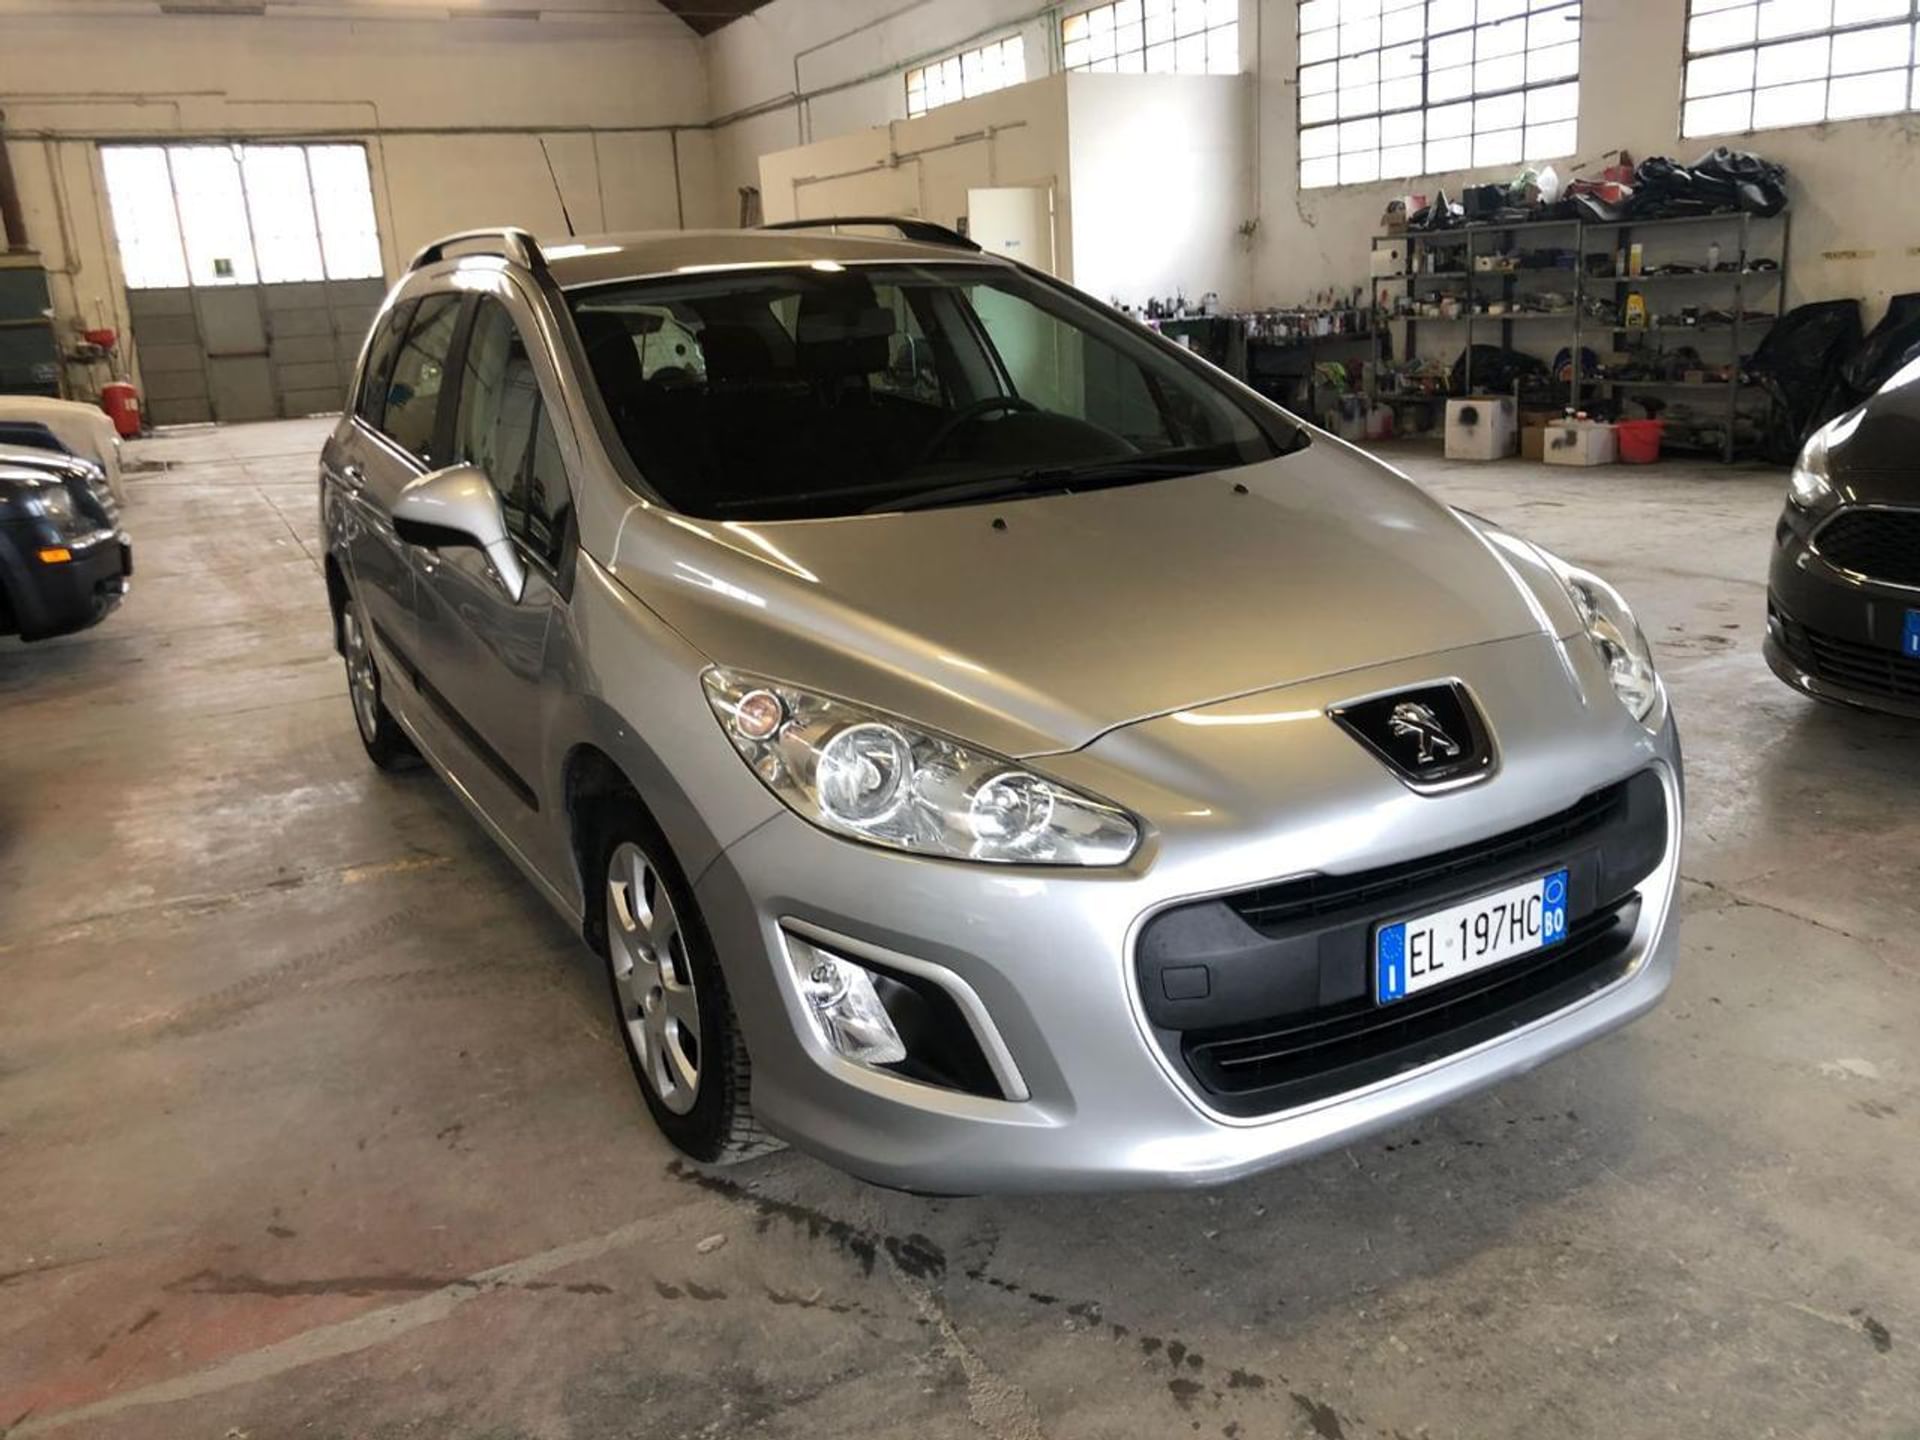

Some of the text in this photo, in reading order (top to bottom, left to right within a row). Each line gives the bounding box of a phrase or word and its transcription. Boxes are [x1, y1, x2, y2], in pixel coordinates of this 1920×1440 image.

[1410, 895, 1541, 978] EL 197HC
[1545, 907, 1564, 937] BO
[1389, 965, 1396, 993] I
